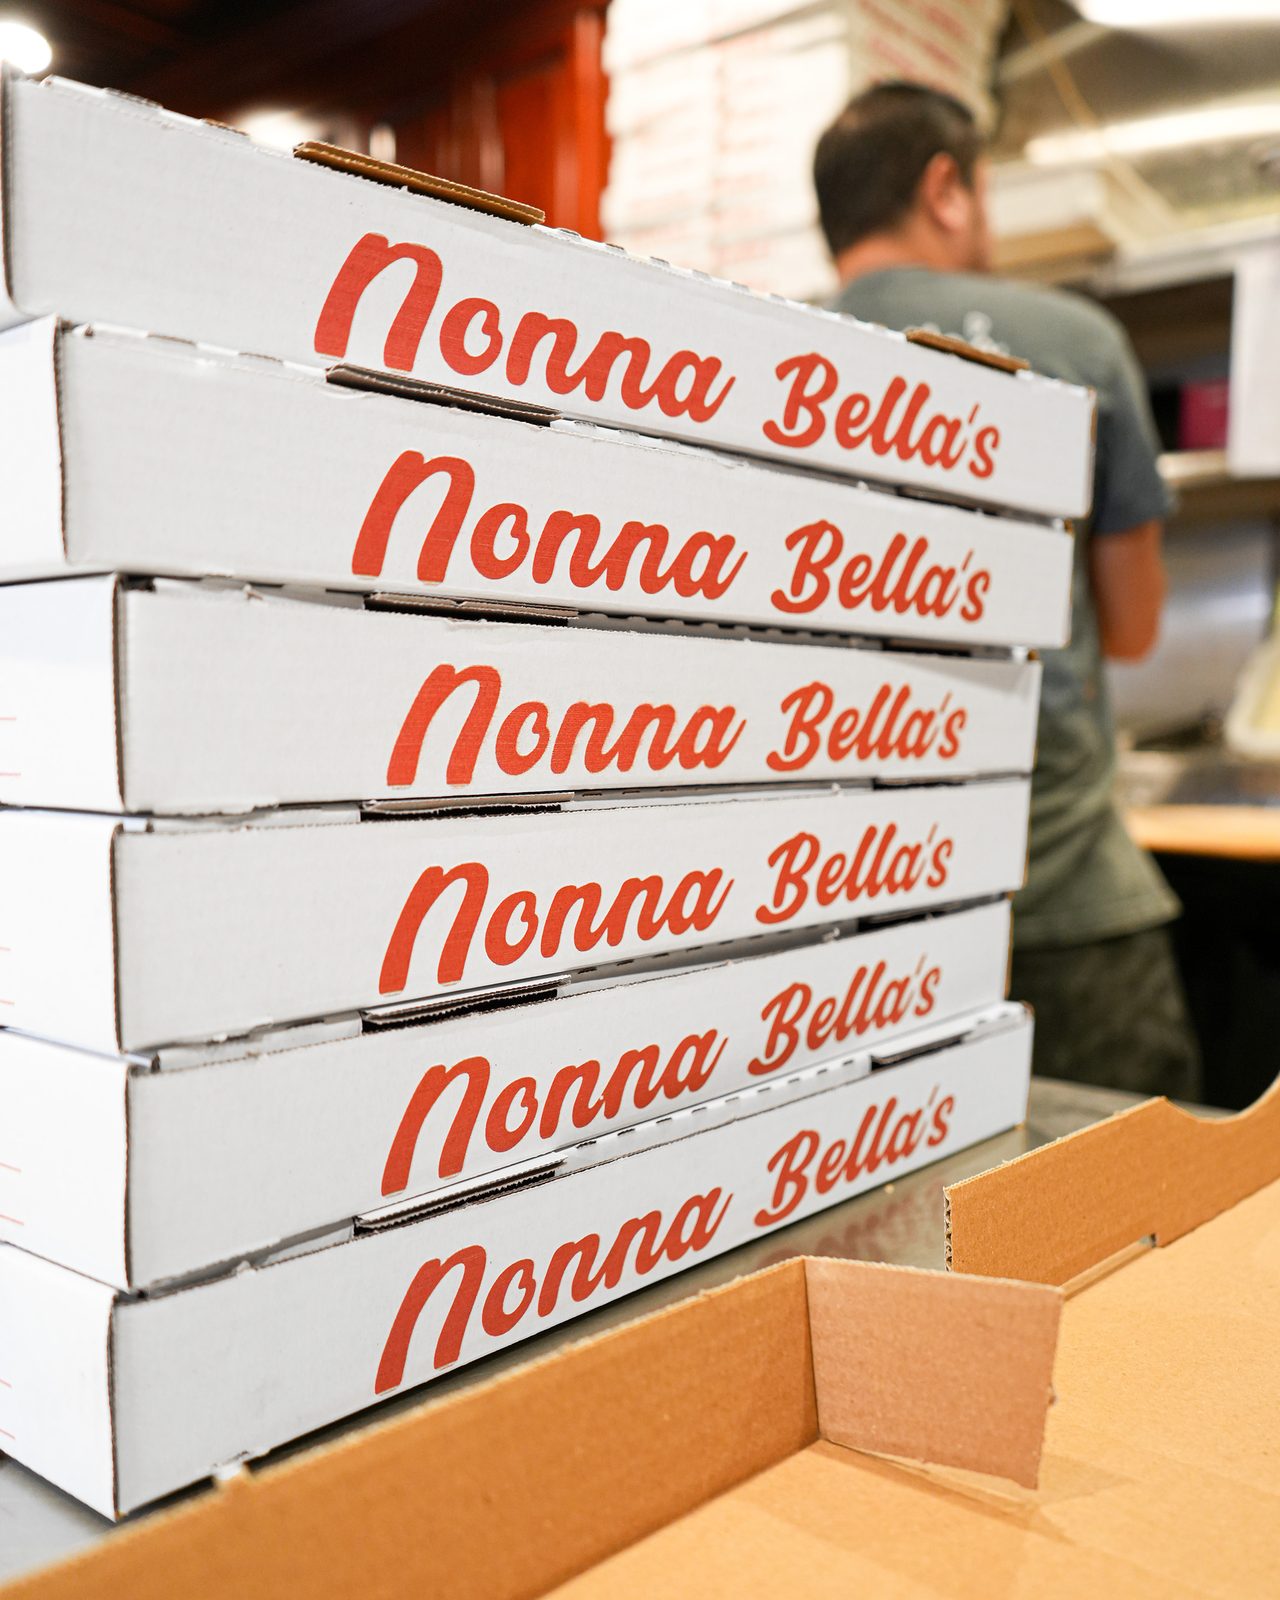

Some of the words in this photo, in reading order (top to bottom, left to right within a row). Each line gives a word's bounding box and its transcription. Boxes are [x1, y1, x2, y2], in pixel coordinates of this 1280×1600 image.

[315, 233, 735, 423] Nonna
[763, 352, 1000, 479] Bella's
[352, 450, 747, 600] Nonna
[771, 520, 991, 622] Bella's
[387, 664, 746, 787] Nonna
[766, 681, 967, 772] Bella's
[379, 862, 734, 995] Nonna
[756, 824, 953, 925] Bella's
[381, 1028, 728, 1197] Nonna
[748, 955, 940, 1076] Bella's
[375, 1188, 733, 1395] Nonna
[754, 1086, 955, 1228] Bella's
